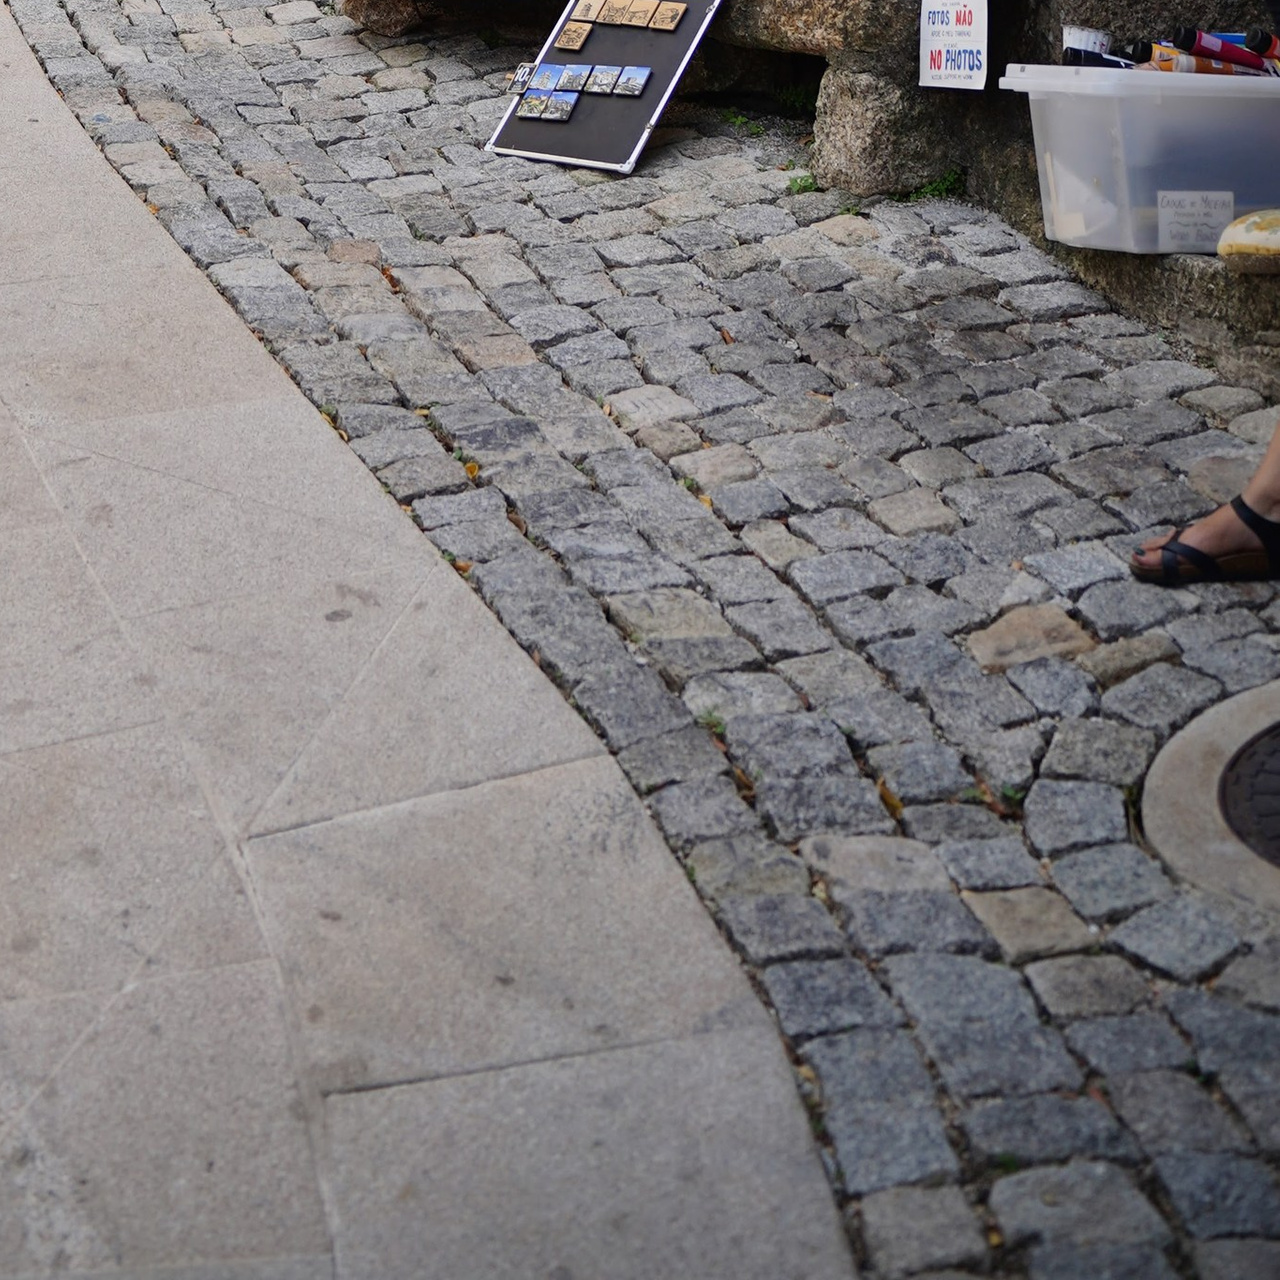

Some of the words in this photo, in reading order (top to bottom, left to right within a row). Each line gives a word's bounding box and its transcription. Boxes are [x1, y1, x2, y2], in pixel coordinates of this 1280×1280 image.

[927, 10, 950, 26] FOTOS
[955, 4, 973, 26] NÃO
[929, 49, 942, 71] NO
[945, 49, 982, 72] PHOTOS
